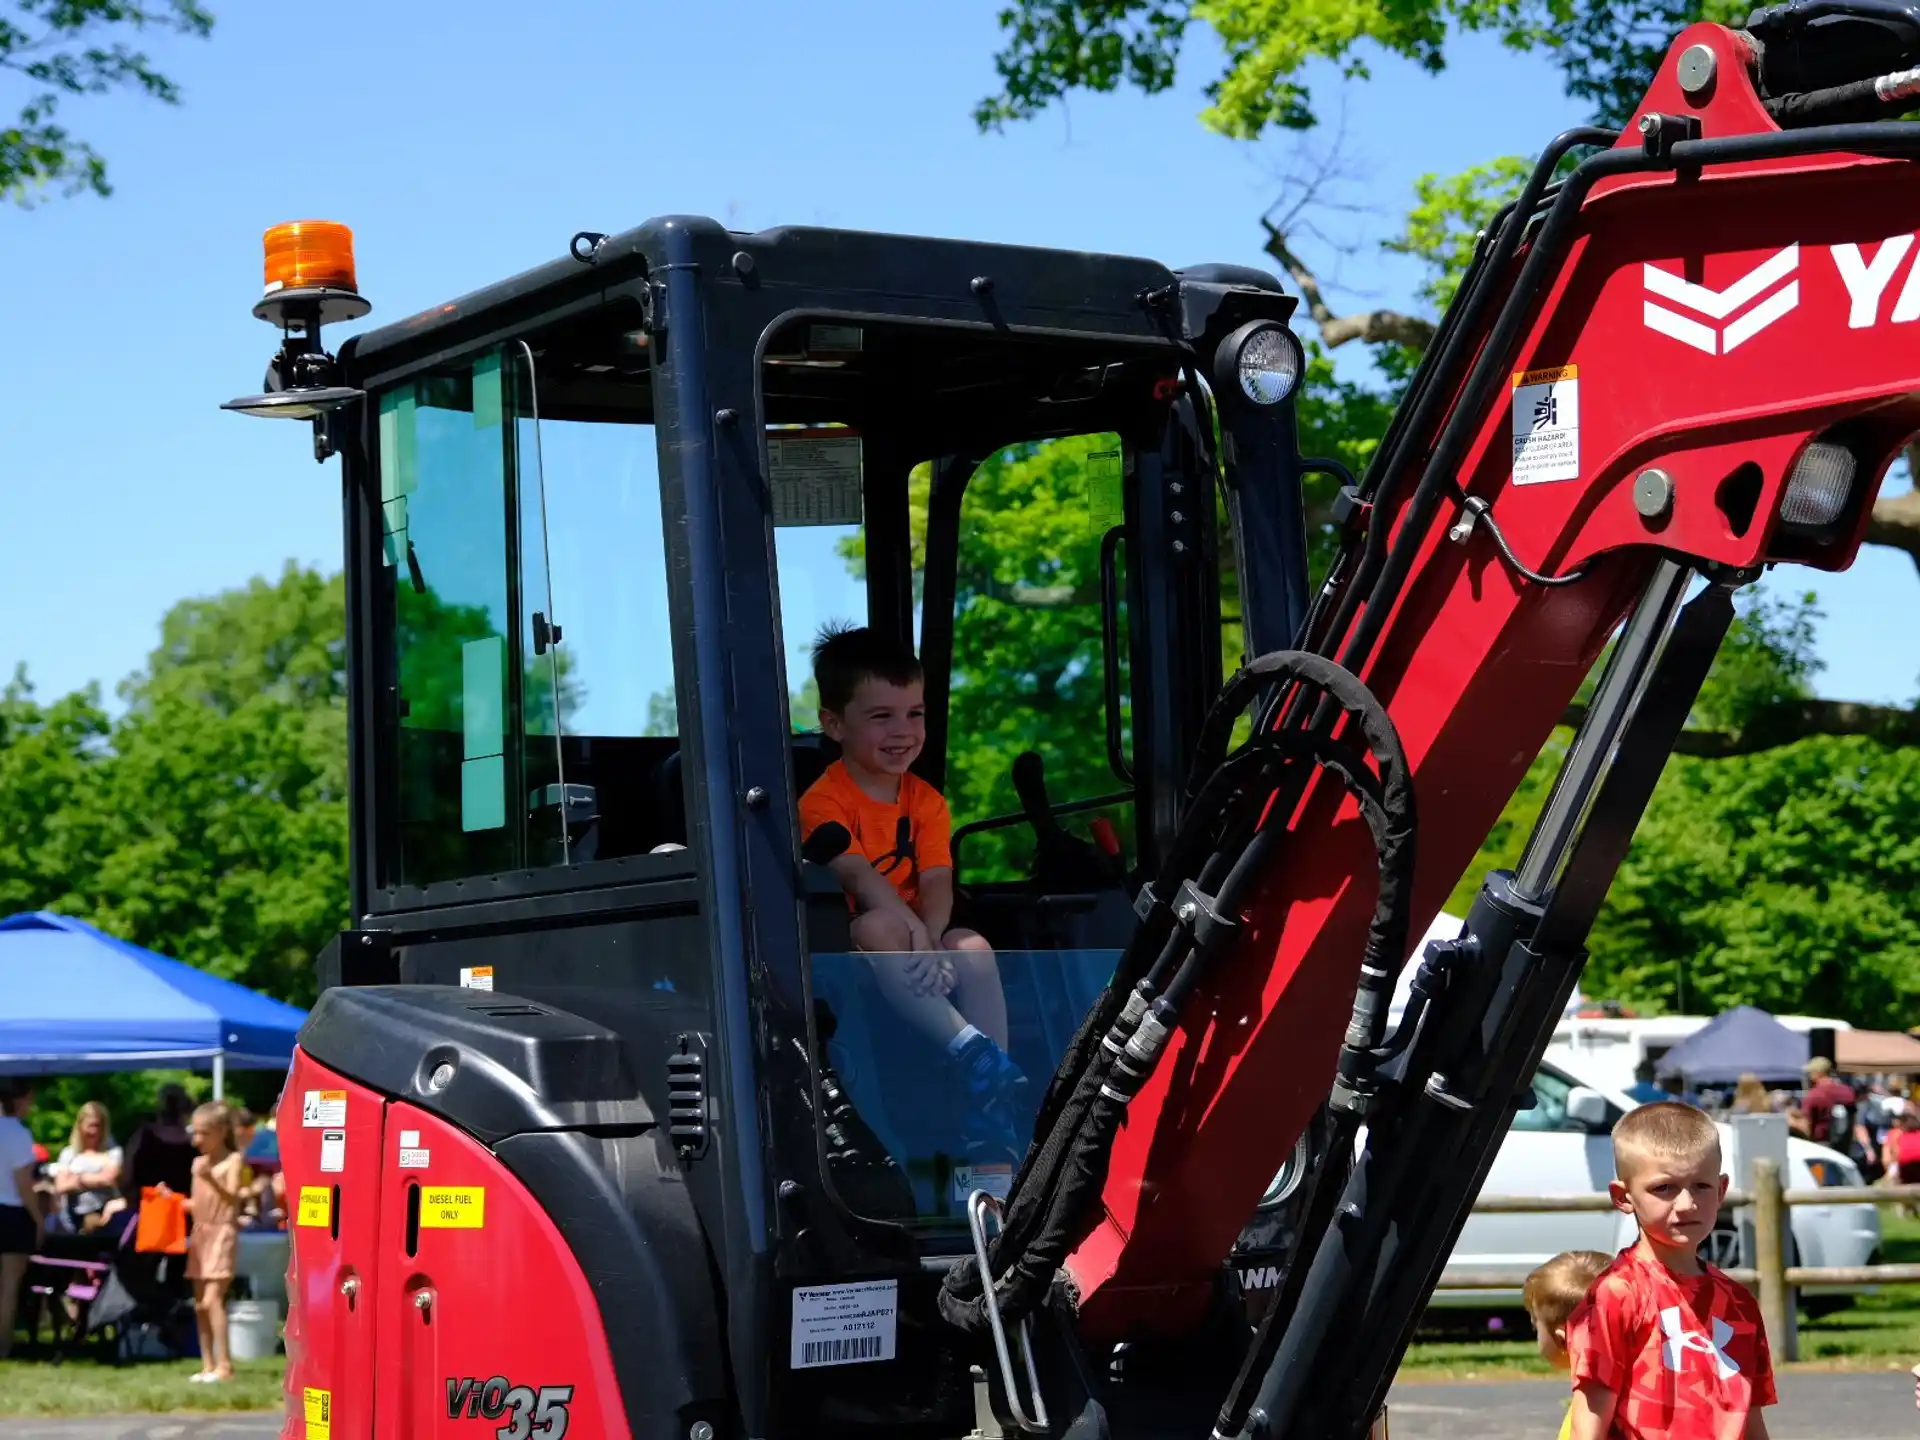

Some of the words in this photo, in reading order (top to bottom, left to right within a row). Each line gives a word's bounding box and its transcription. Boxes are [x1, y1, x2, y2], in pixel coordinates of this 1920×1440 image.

[1530, 368, 1568, 382] WARNING
[1514, 436, 1537, 445] CRUSH
[429, 1194, 453, 1204] DIESEL
[455, 1194, 472, 1204] FUEL
[440, 1210, 459, 1220] ONLY
